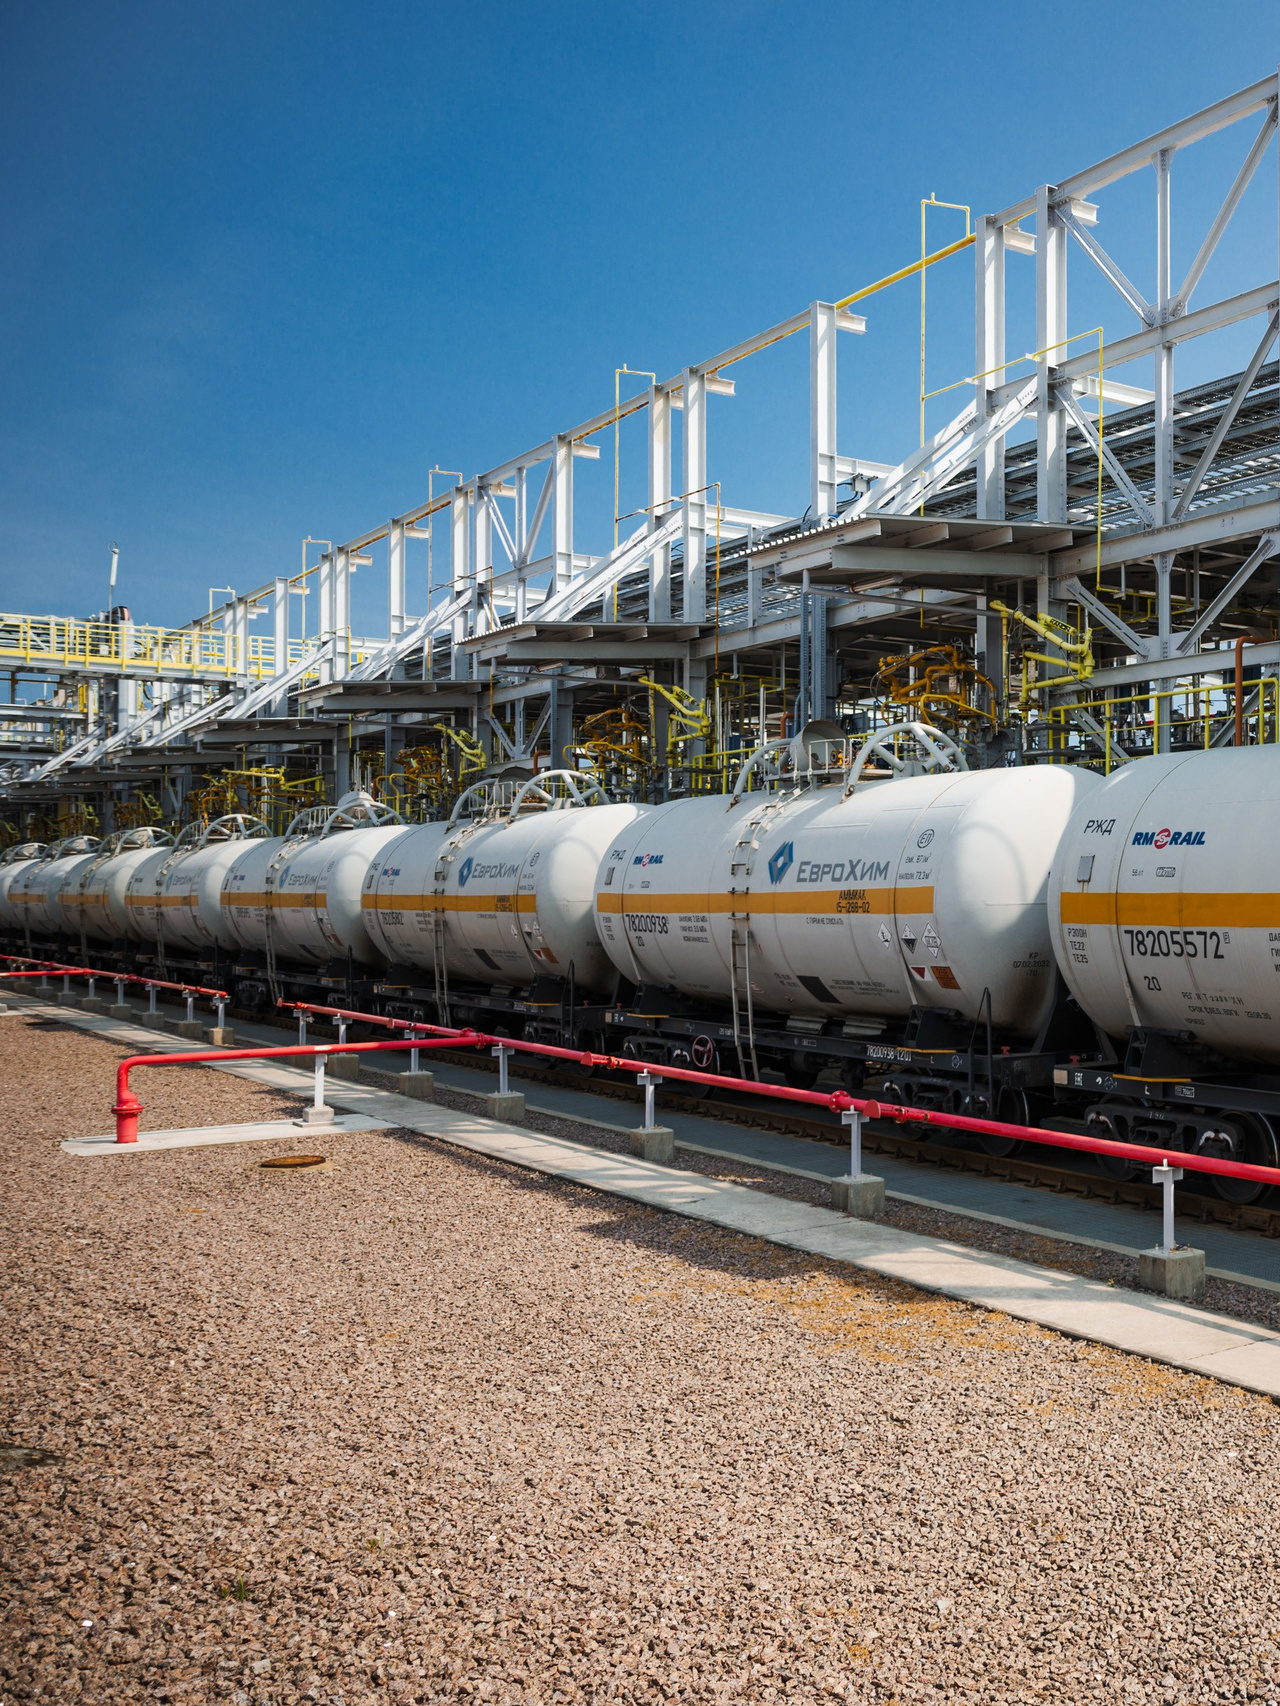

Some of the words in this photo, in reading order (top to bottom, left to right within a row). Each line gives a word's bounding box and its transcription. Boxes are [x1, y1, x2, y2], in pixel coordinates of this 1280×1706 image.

[1084, 819, 1116, 835] РЖД
[625, 914, 669, 934] 78200938
[1124, 930, 1224, 959] 78205572
[1144, 975, 1162, 991] 20
